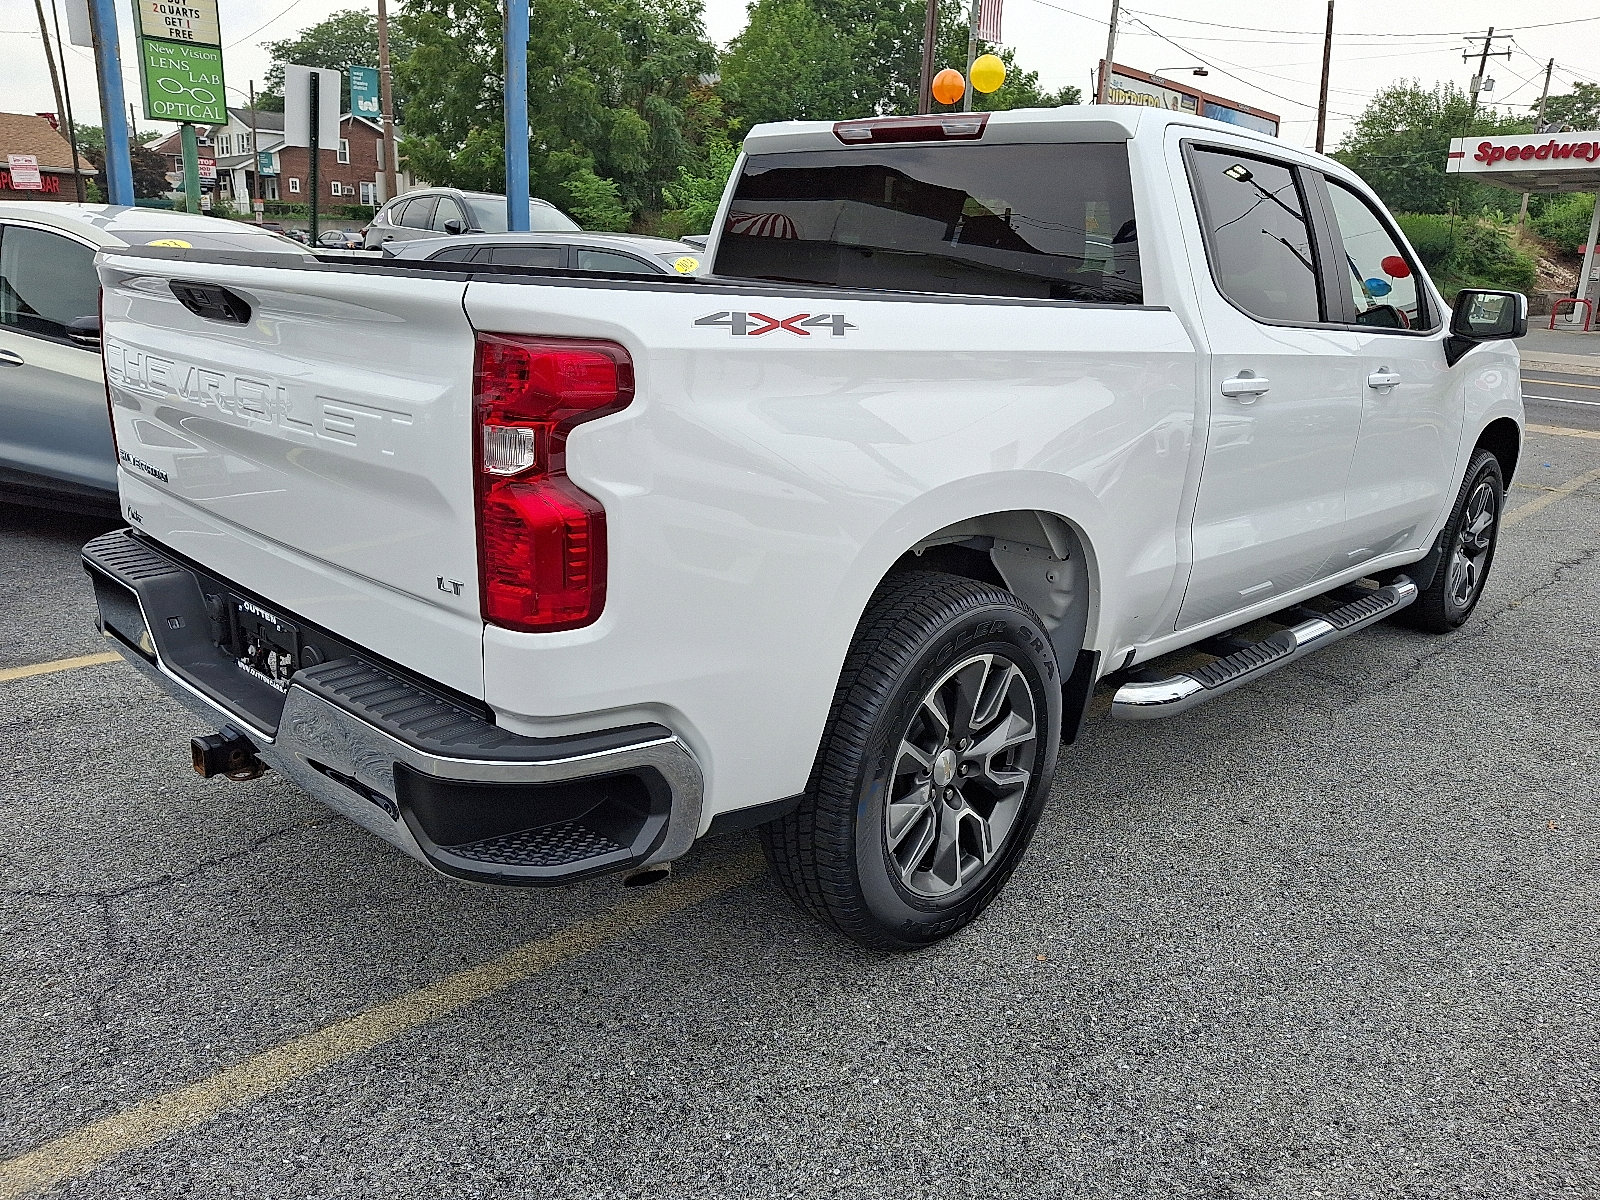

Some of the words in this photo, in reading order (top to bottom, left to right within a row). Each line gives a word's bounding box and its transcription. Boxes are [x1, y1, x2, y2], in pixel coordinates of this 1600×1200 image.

[165, 17, 182, 27] GET
[169, 28, 194, 39] FREE
[148, 43, 174, 54] New
[180, 47, 217, 60] Vision
[150, 56, 190, 71] LENS
[189, 71, 220, 84] LAB
[153, 100, 223, 120] OPTICAL
[1474, 140, 1600, 166] Speedway
[106, 343, 414, 455] CHEVROLET
[436, 575, 464, 596] LT
[243, 601, 277, 625] OUTTEN
